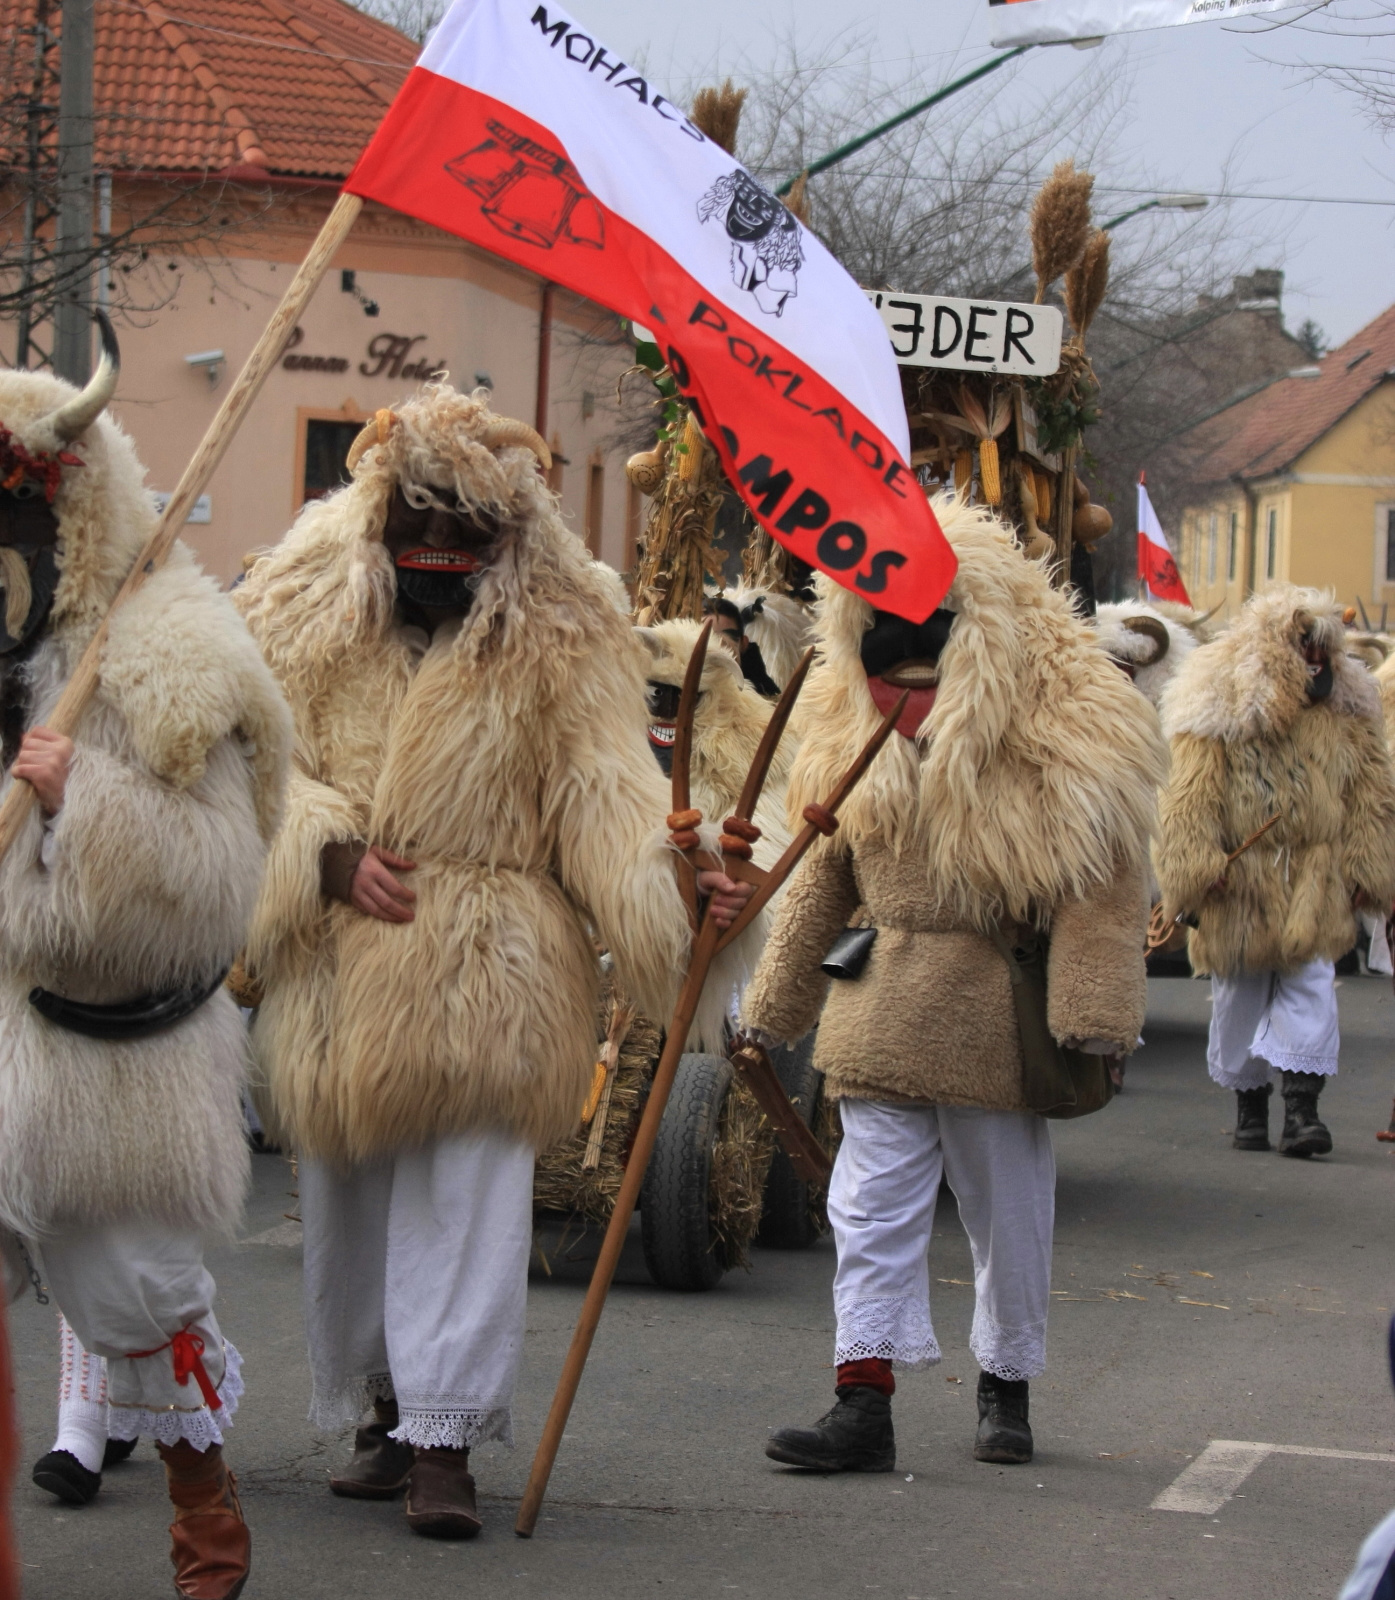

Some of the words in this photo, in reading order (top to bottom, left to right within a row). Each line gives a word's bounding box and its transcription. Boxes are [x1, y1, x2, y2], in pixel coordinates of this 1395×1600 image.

[1191, 0, 1226, 14] Kolping
[530, 5, 706, 143] MOHACS
[873, 294, 1035, 365] JDER
[688, 300, 907, 499] POKLADE
